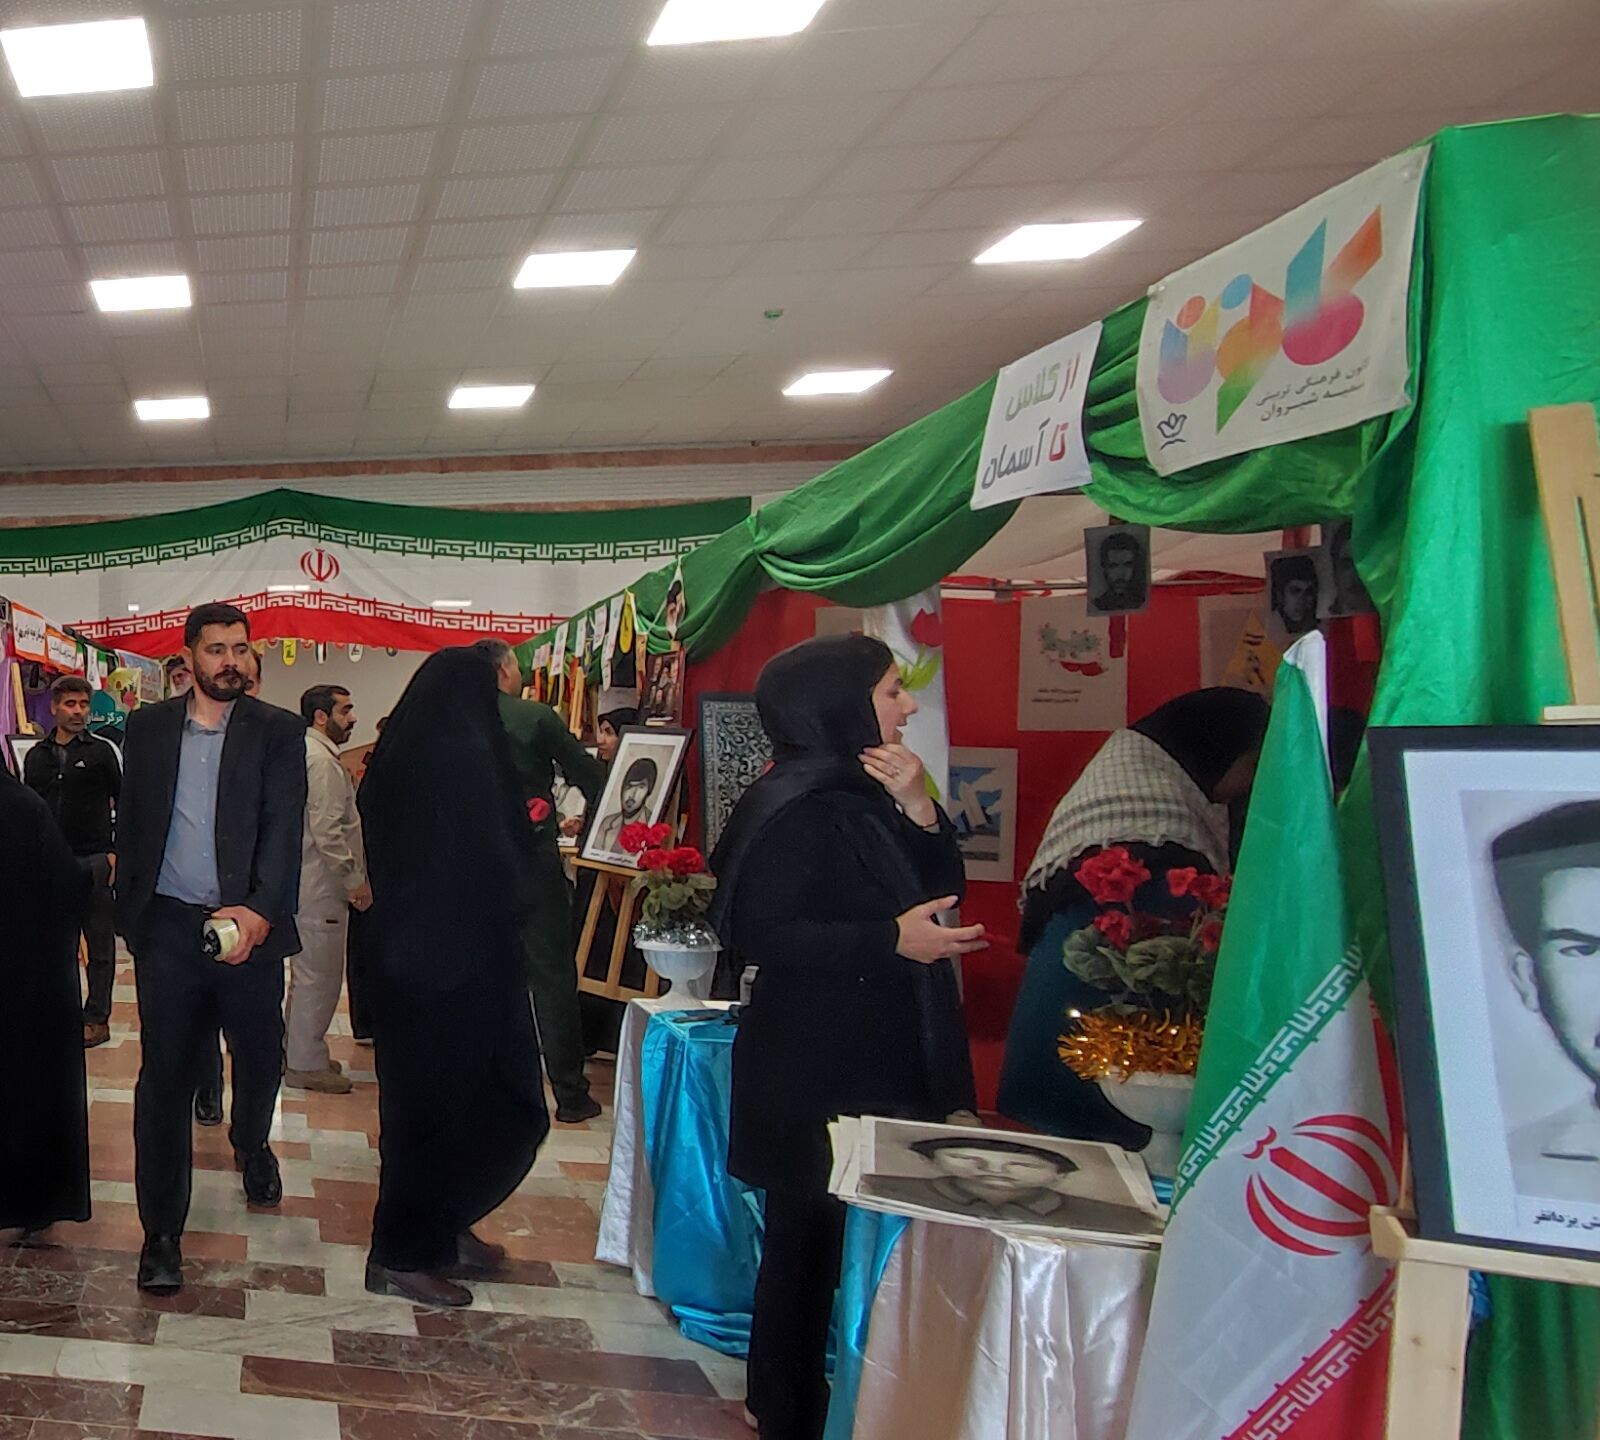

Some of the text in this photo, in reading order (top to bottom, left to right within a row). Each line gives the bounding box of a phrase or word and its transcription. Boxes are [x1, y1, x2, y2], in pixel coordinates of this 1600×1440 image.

[1005, 352, 1081, 422] از کلاس
[981, 417, 1070, 490] تا آسمان
